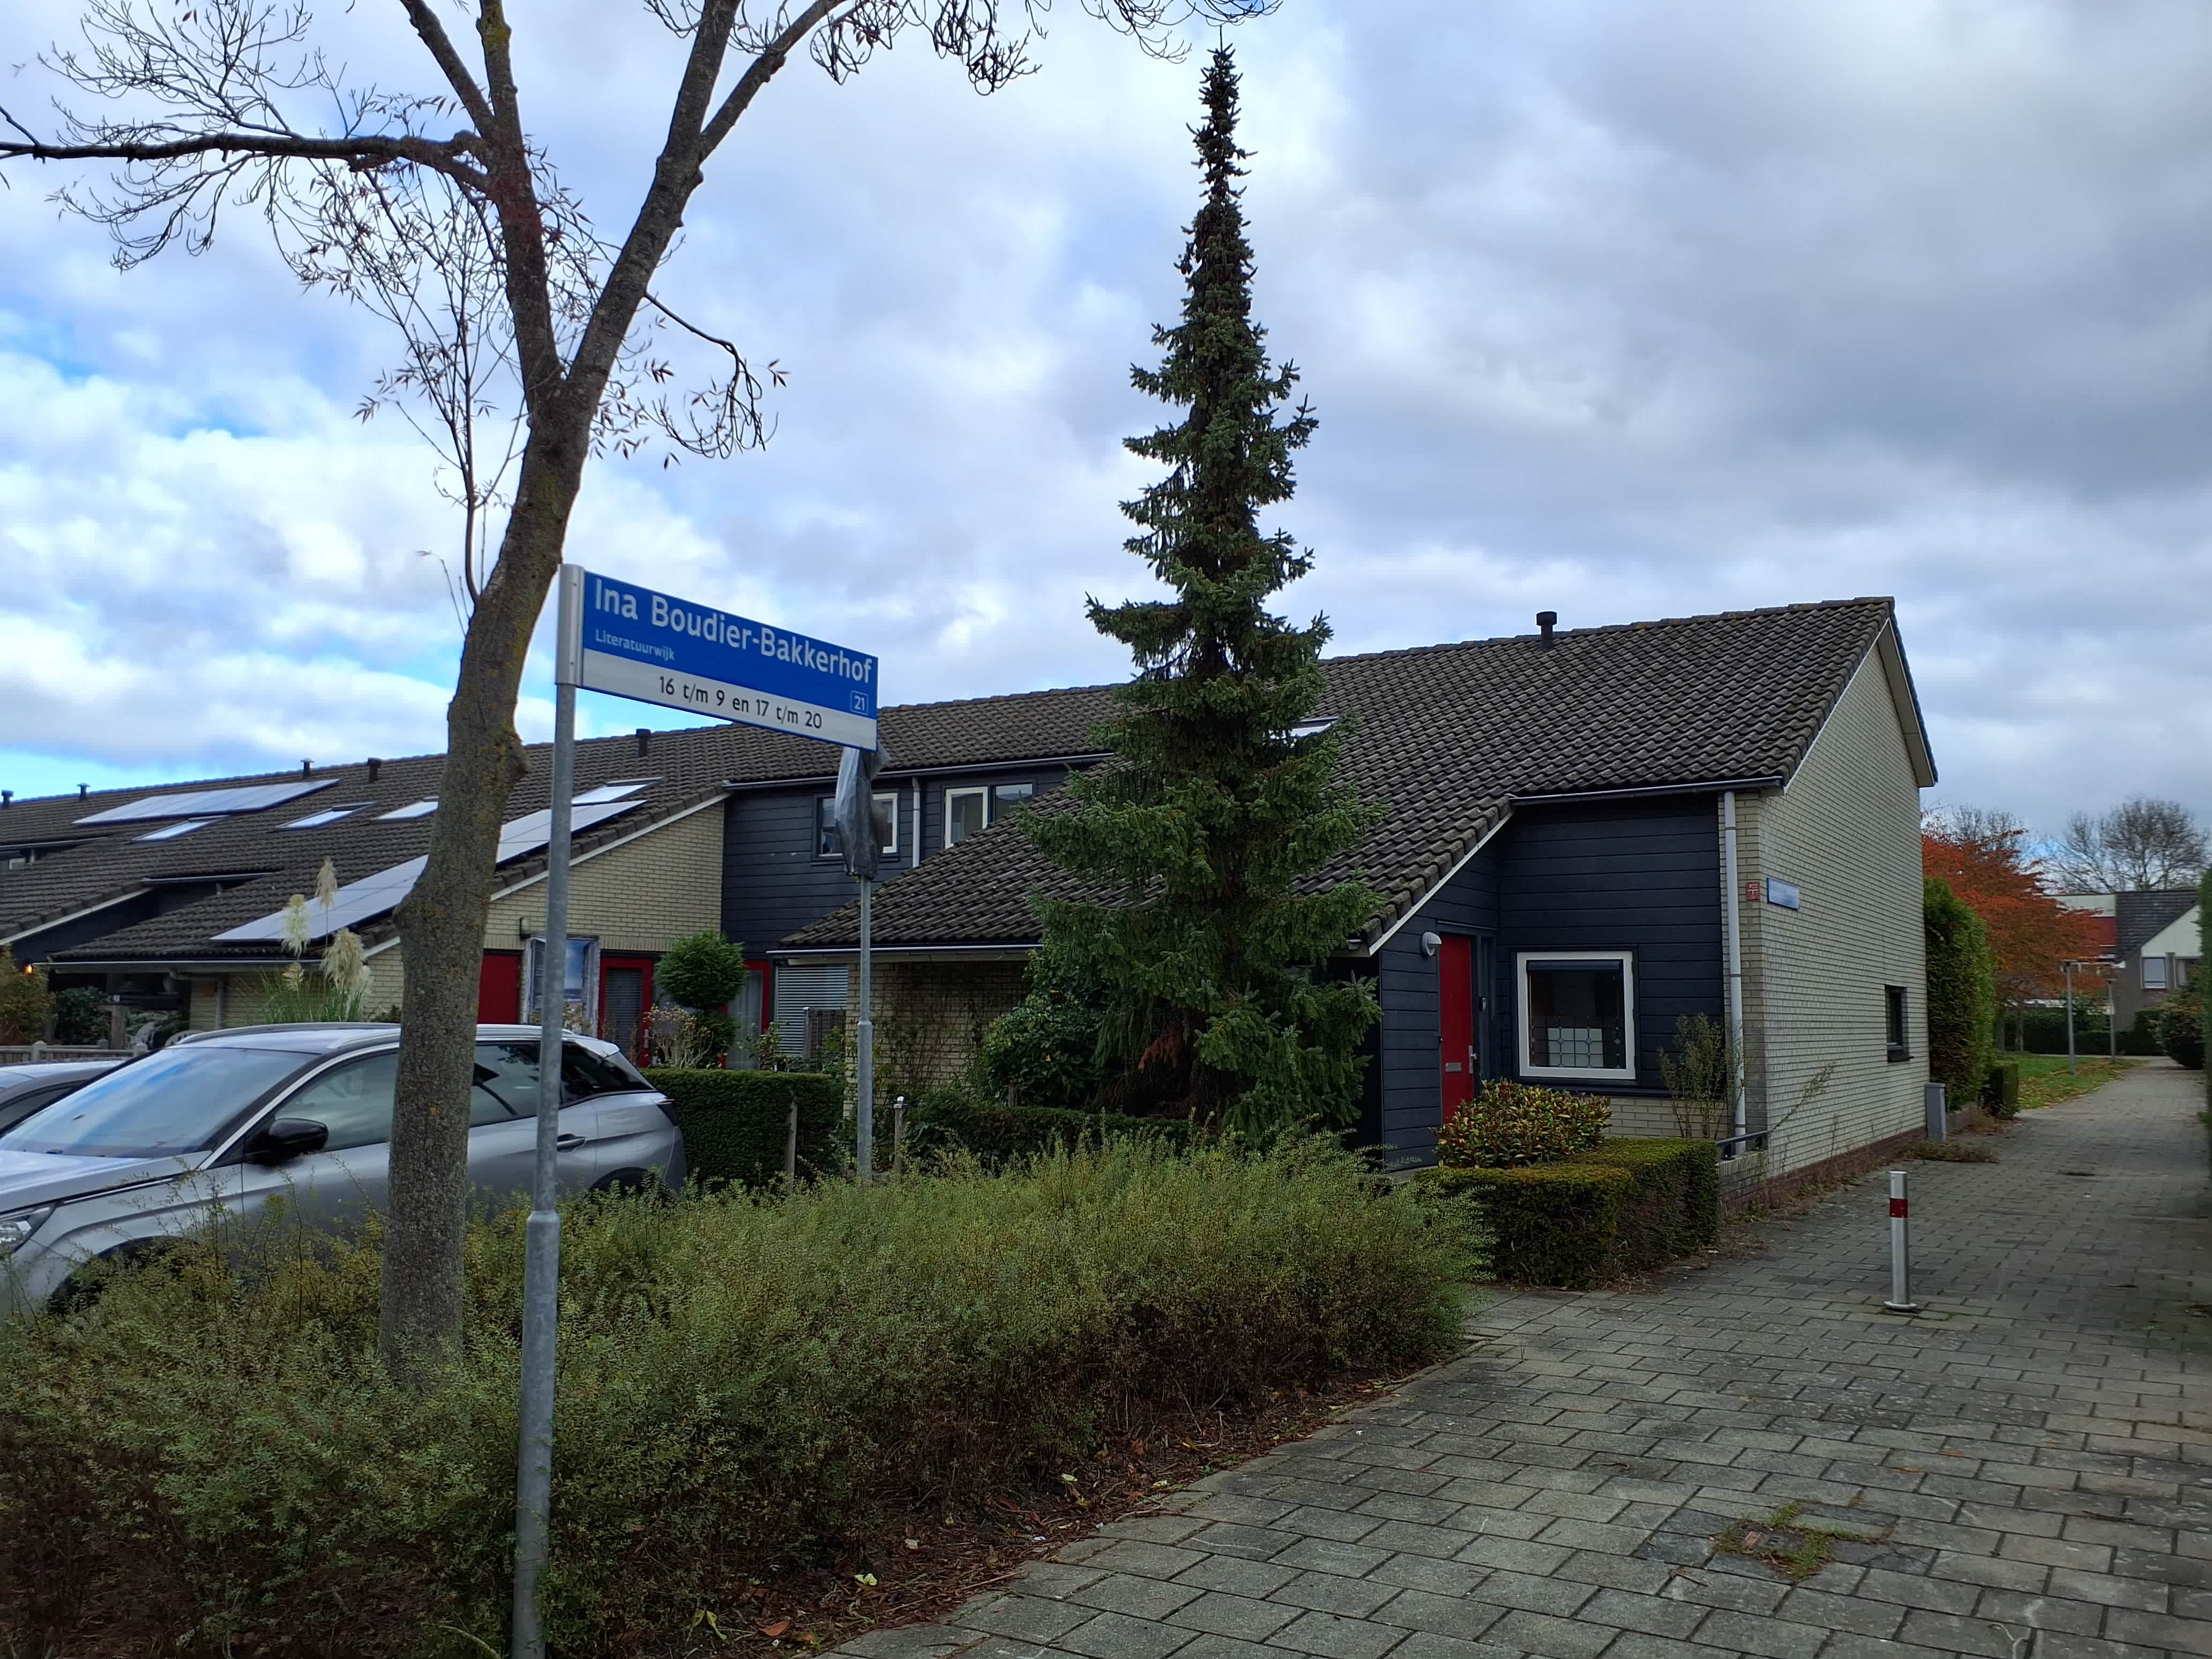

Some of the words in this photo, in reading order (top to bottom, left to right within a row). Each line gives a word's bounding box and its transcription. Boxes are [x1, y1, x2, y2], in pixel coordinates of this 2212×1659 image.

[595, 578, 638, 620] Ina
[652, 594, 872, 684] Boudier-Bakkerhof
[595, 628, 675, 661] Literatuurwijk
[660, 676, 675, 695] 16
[683, 683, 708, 704] t/m
[716, 689, 725, 706] 9
[733, 697, 749, 713] en
[756, 699, 769, 716] 17
[776, 705, 798, 724] t/m
[805, 711, 822, 729] 20
[854, 695, 865, 711] 21
